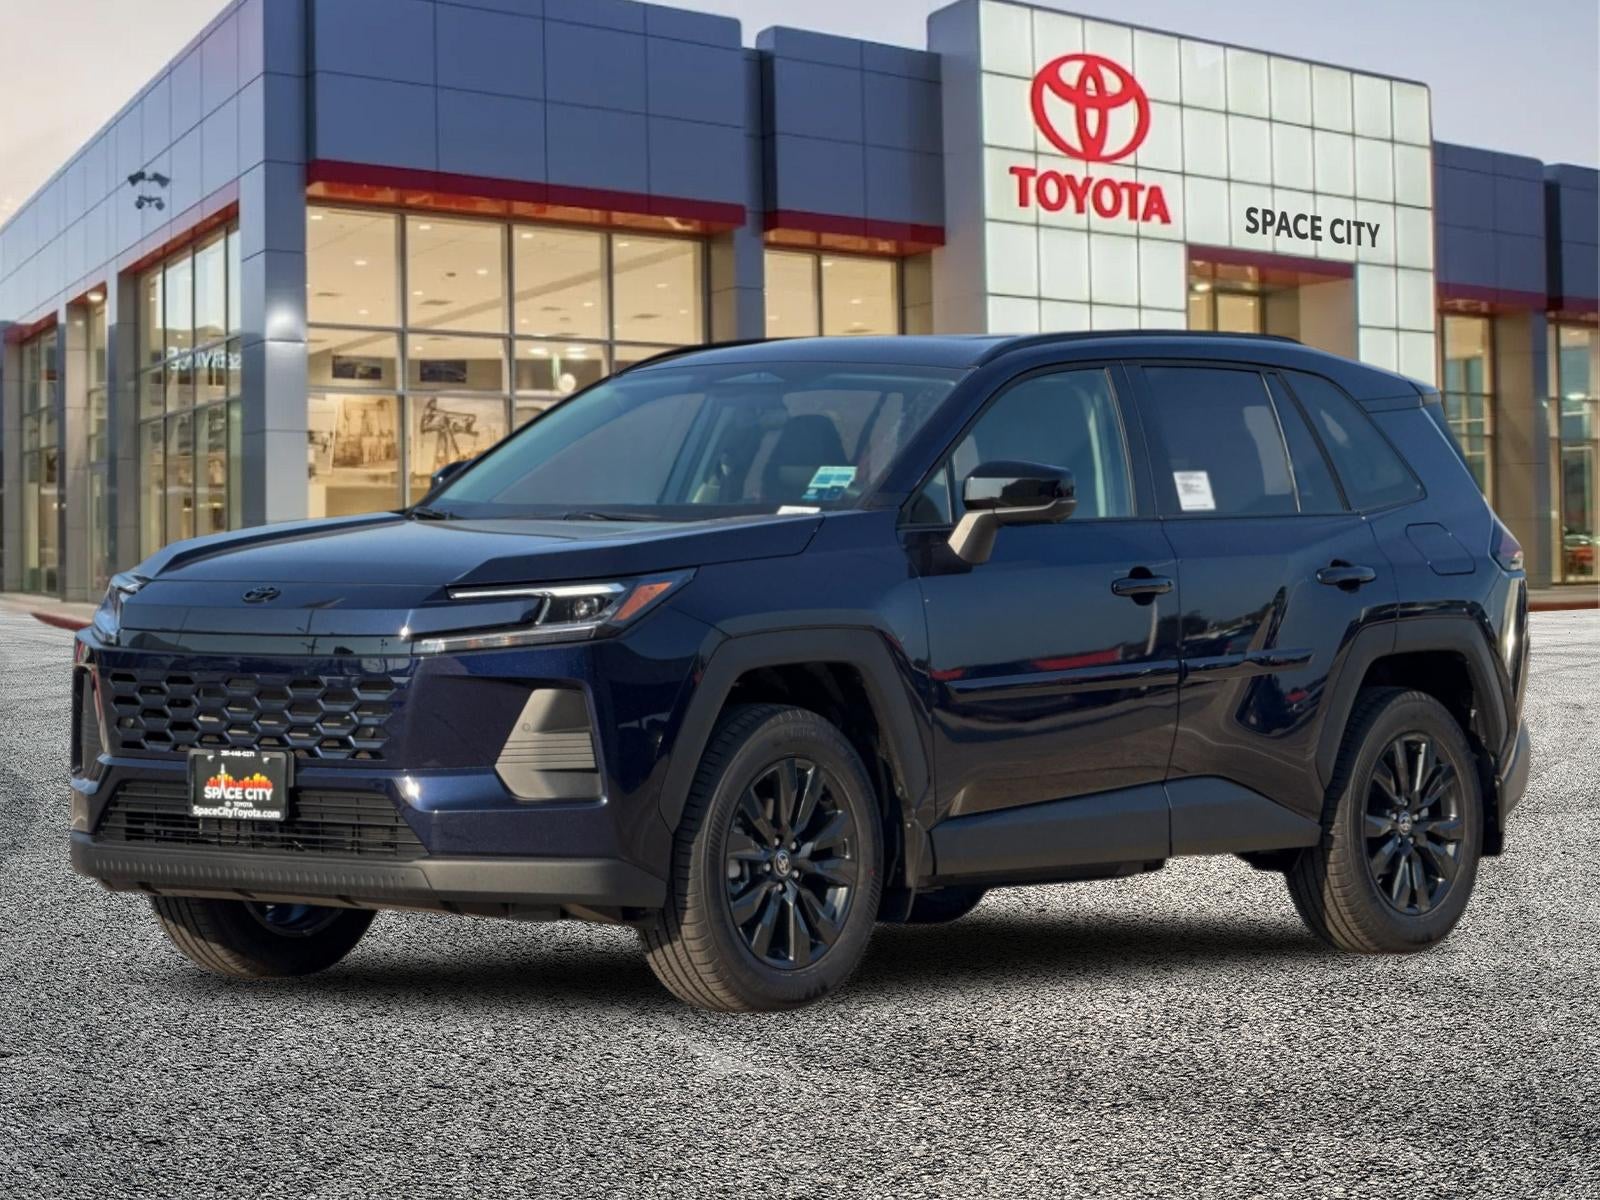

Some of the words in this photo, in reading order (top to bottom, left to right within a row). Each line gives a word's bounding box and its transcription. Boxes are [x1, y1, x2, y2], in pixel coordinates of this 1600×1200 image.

[1009, 166, 1171, 224] TOYOTA
[1245, 206, 1322, 242] SPACE
[1330, 217, 1380, 248] CITY
[204, 785, 243, 799] SPACE
[244, 788, 273, 801] CITY
[193, 805, 280, 819] SpaceCityToyota.com
